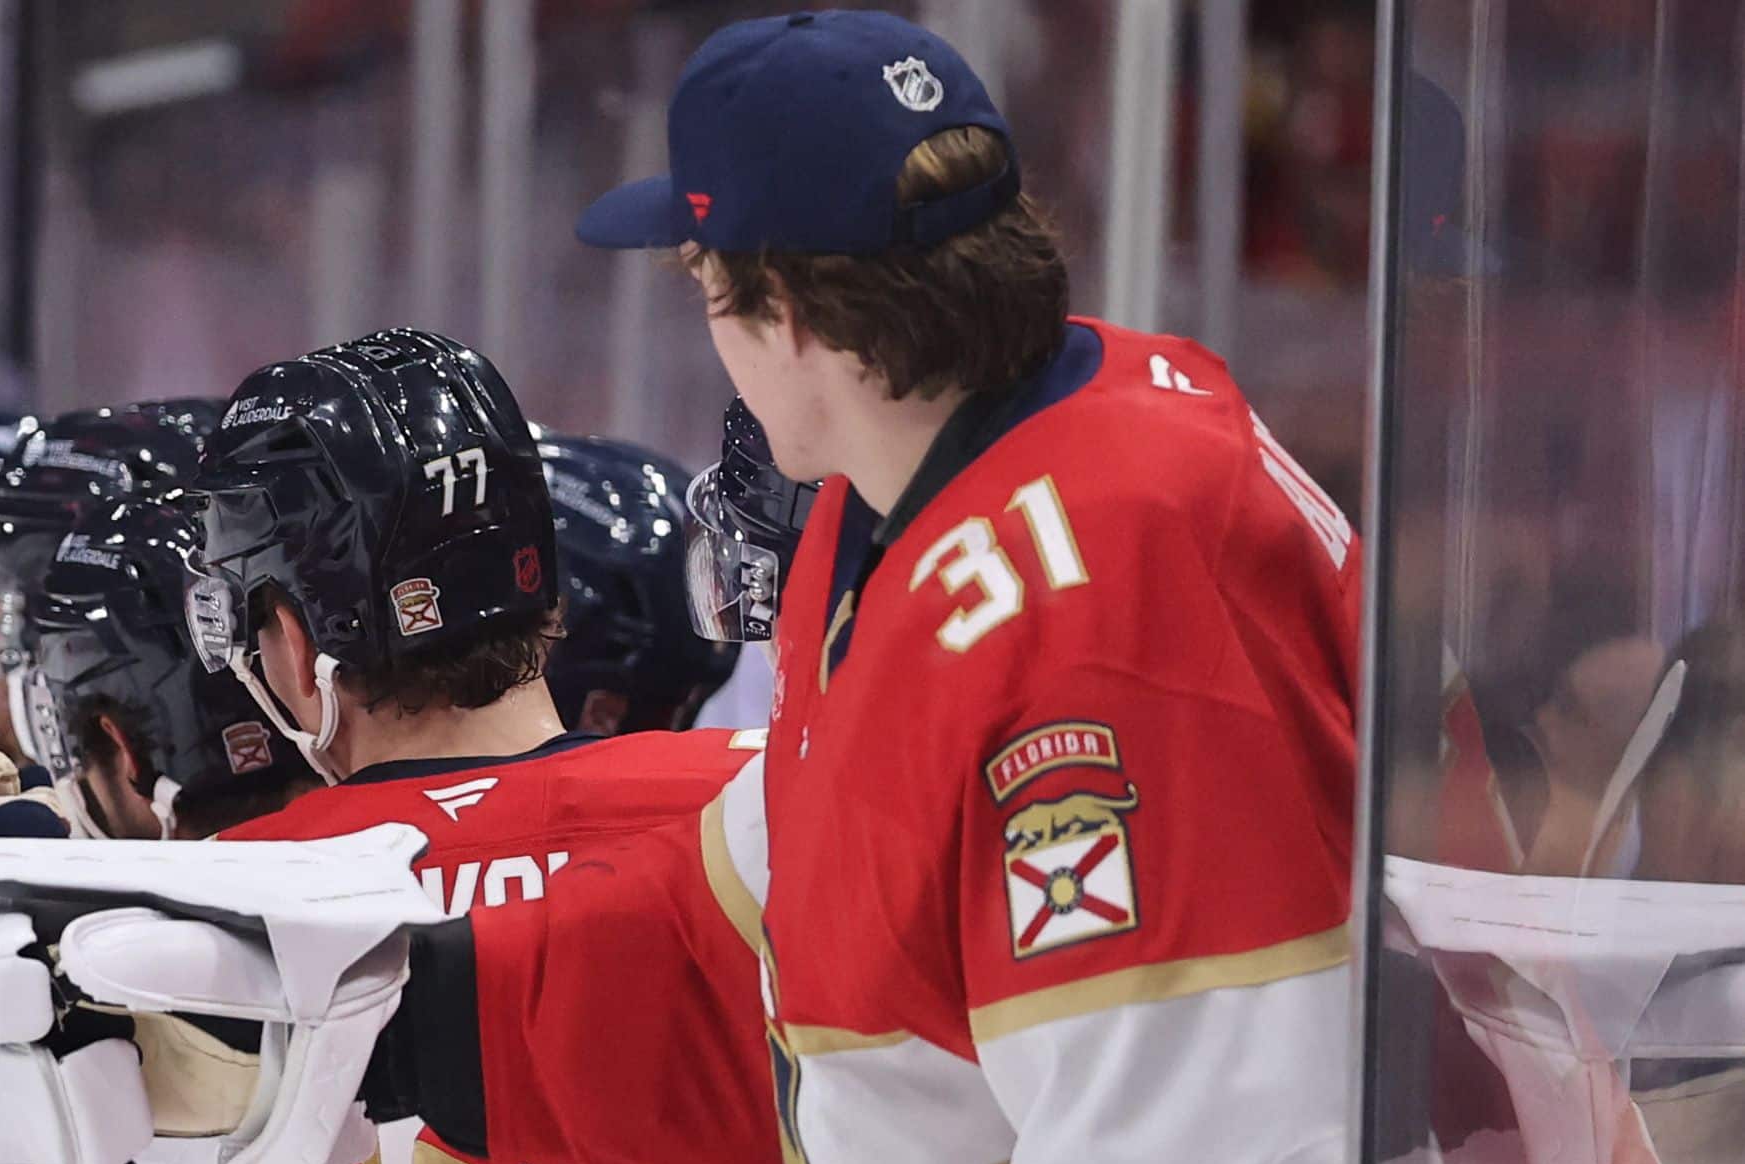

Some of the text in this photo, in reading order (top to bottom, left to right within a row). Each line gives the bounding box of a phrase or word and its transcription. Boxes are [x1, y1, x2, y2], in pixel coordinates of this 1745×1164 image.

[422, 447, 489, 516] 77
[908, 473, 1090, 654] 31
[1000, 731, 1100, 783] FLORIDA
